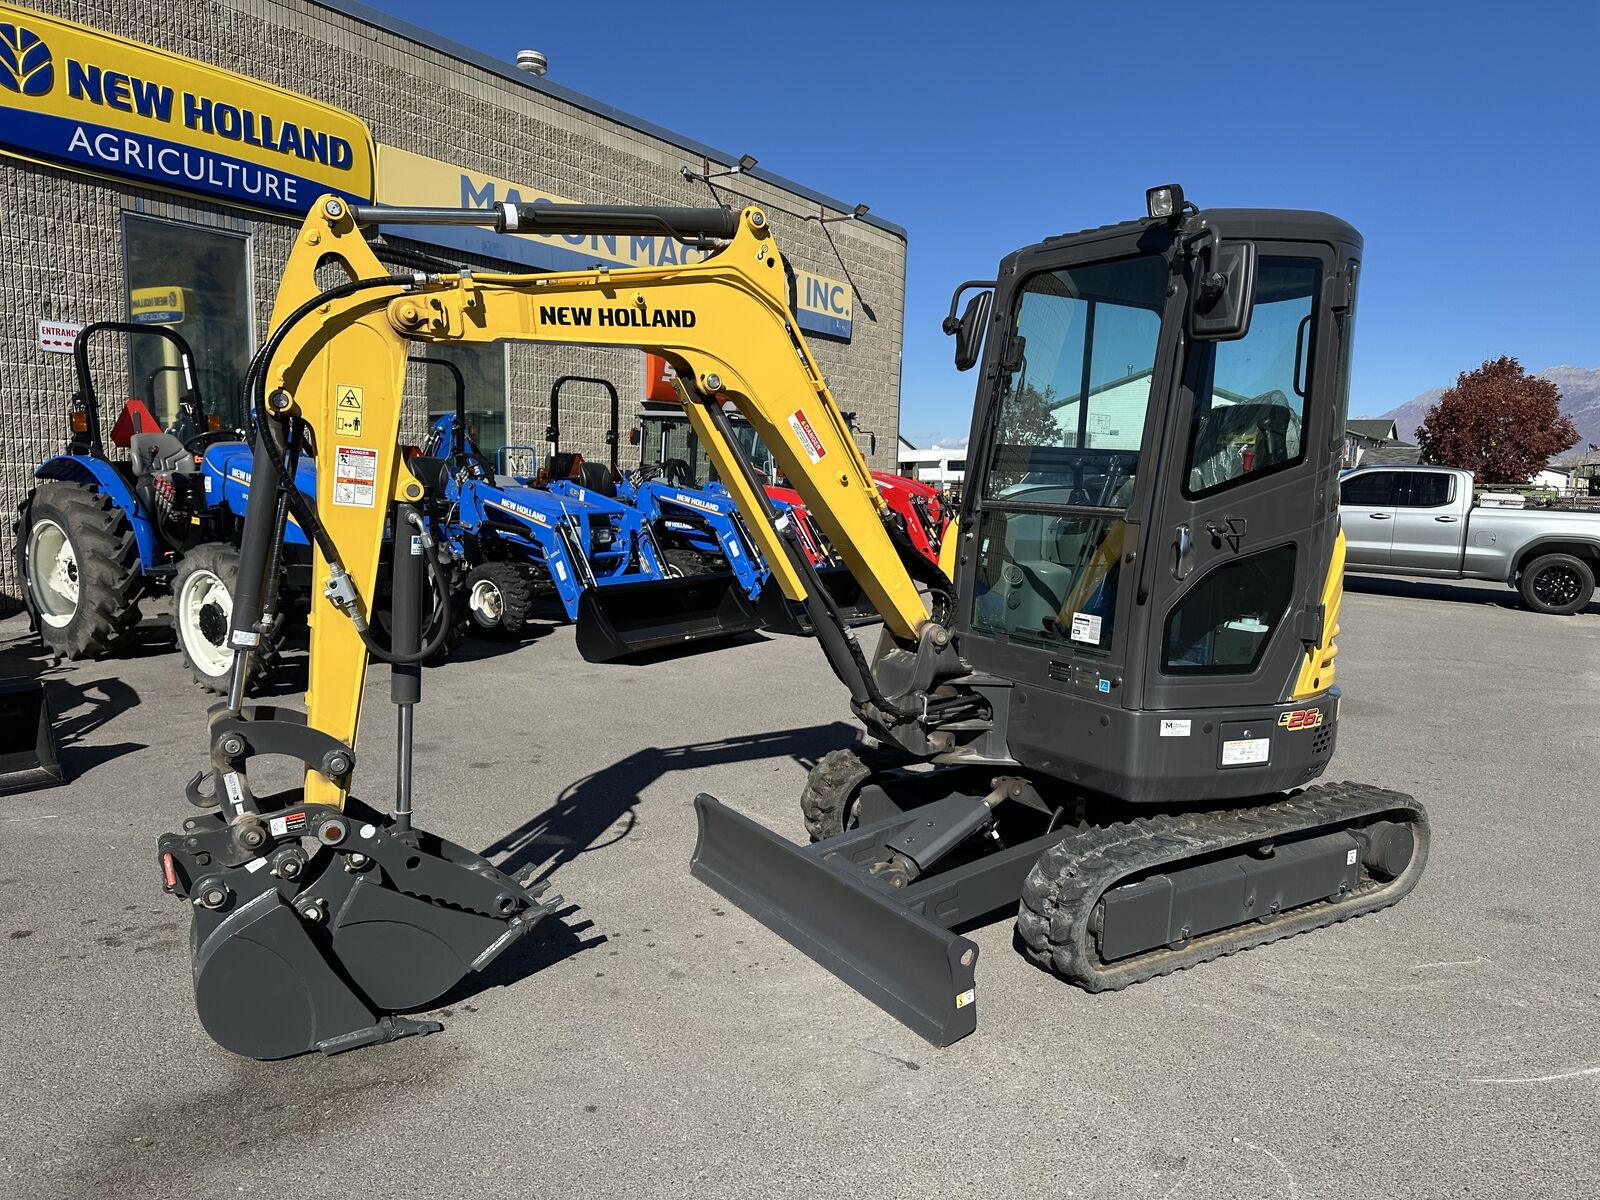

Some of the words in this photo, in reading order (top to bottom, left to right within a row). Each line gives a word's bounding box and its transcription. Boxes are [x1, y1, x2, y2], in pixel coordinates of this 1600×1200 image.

[67, 58, 173, 122] NEW
[182, 91, 353, 170] HOLLAND
[68, 126, 297, 203] AGRICULTURE
[806, 277, 849, 316] INC.
[540, 306, 592, 326] NEW
[598, 308, 696, 328] HOLLAND
[804, 424, 821, 451] DANGER
[232, 467, 245, 480] NEW
[501, 498, 516, 511] NEW
[516, 504, 547, 523] HOLLAND
[676, 493, 691, 504] NEW
[691, 497, 719, 511] HOLLAND
